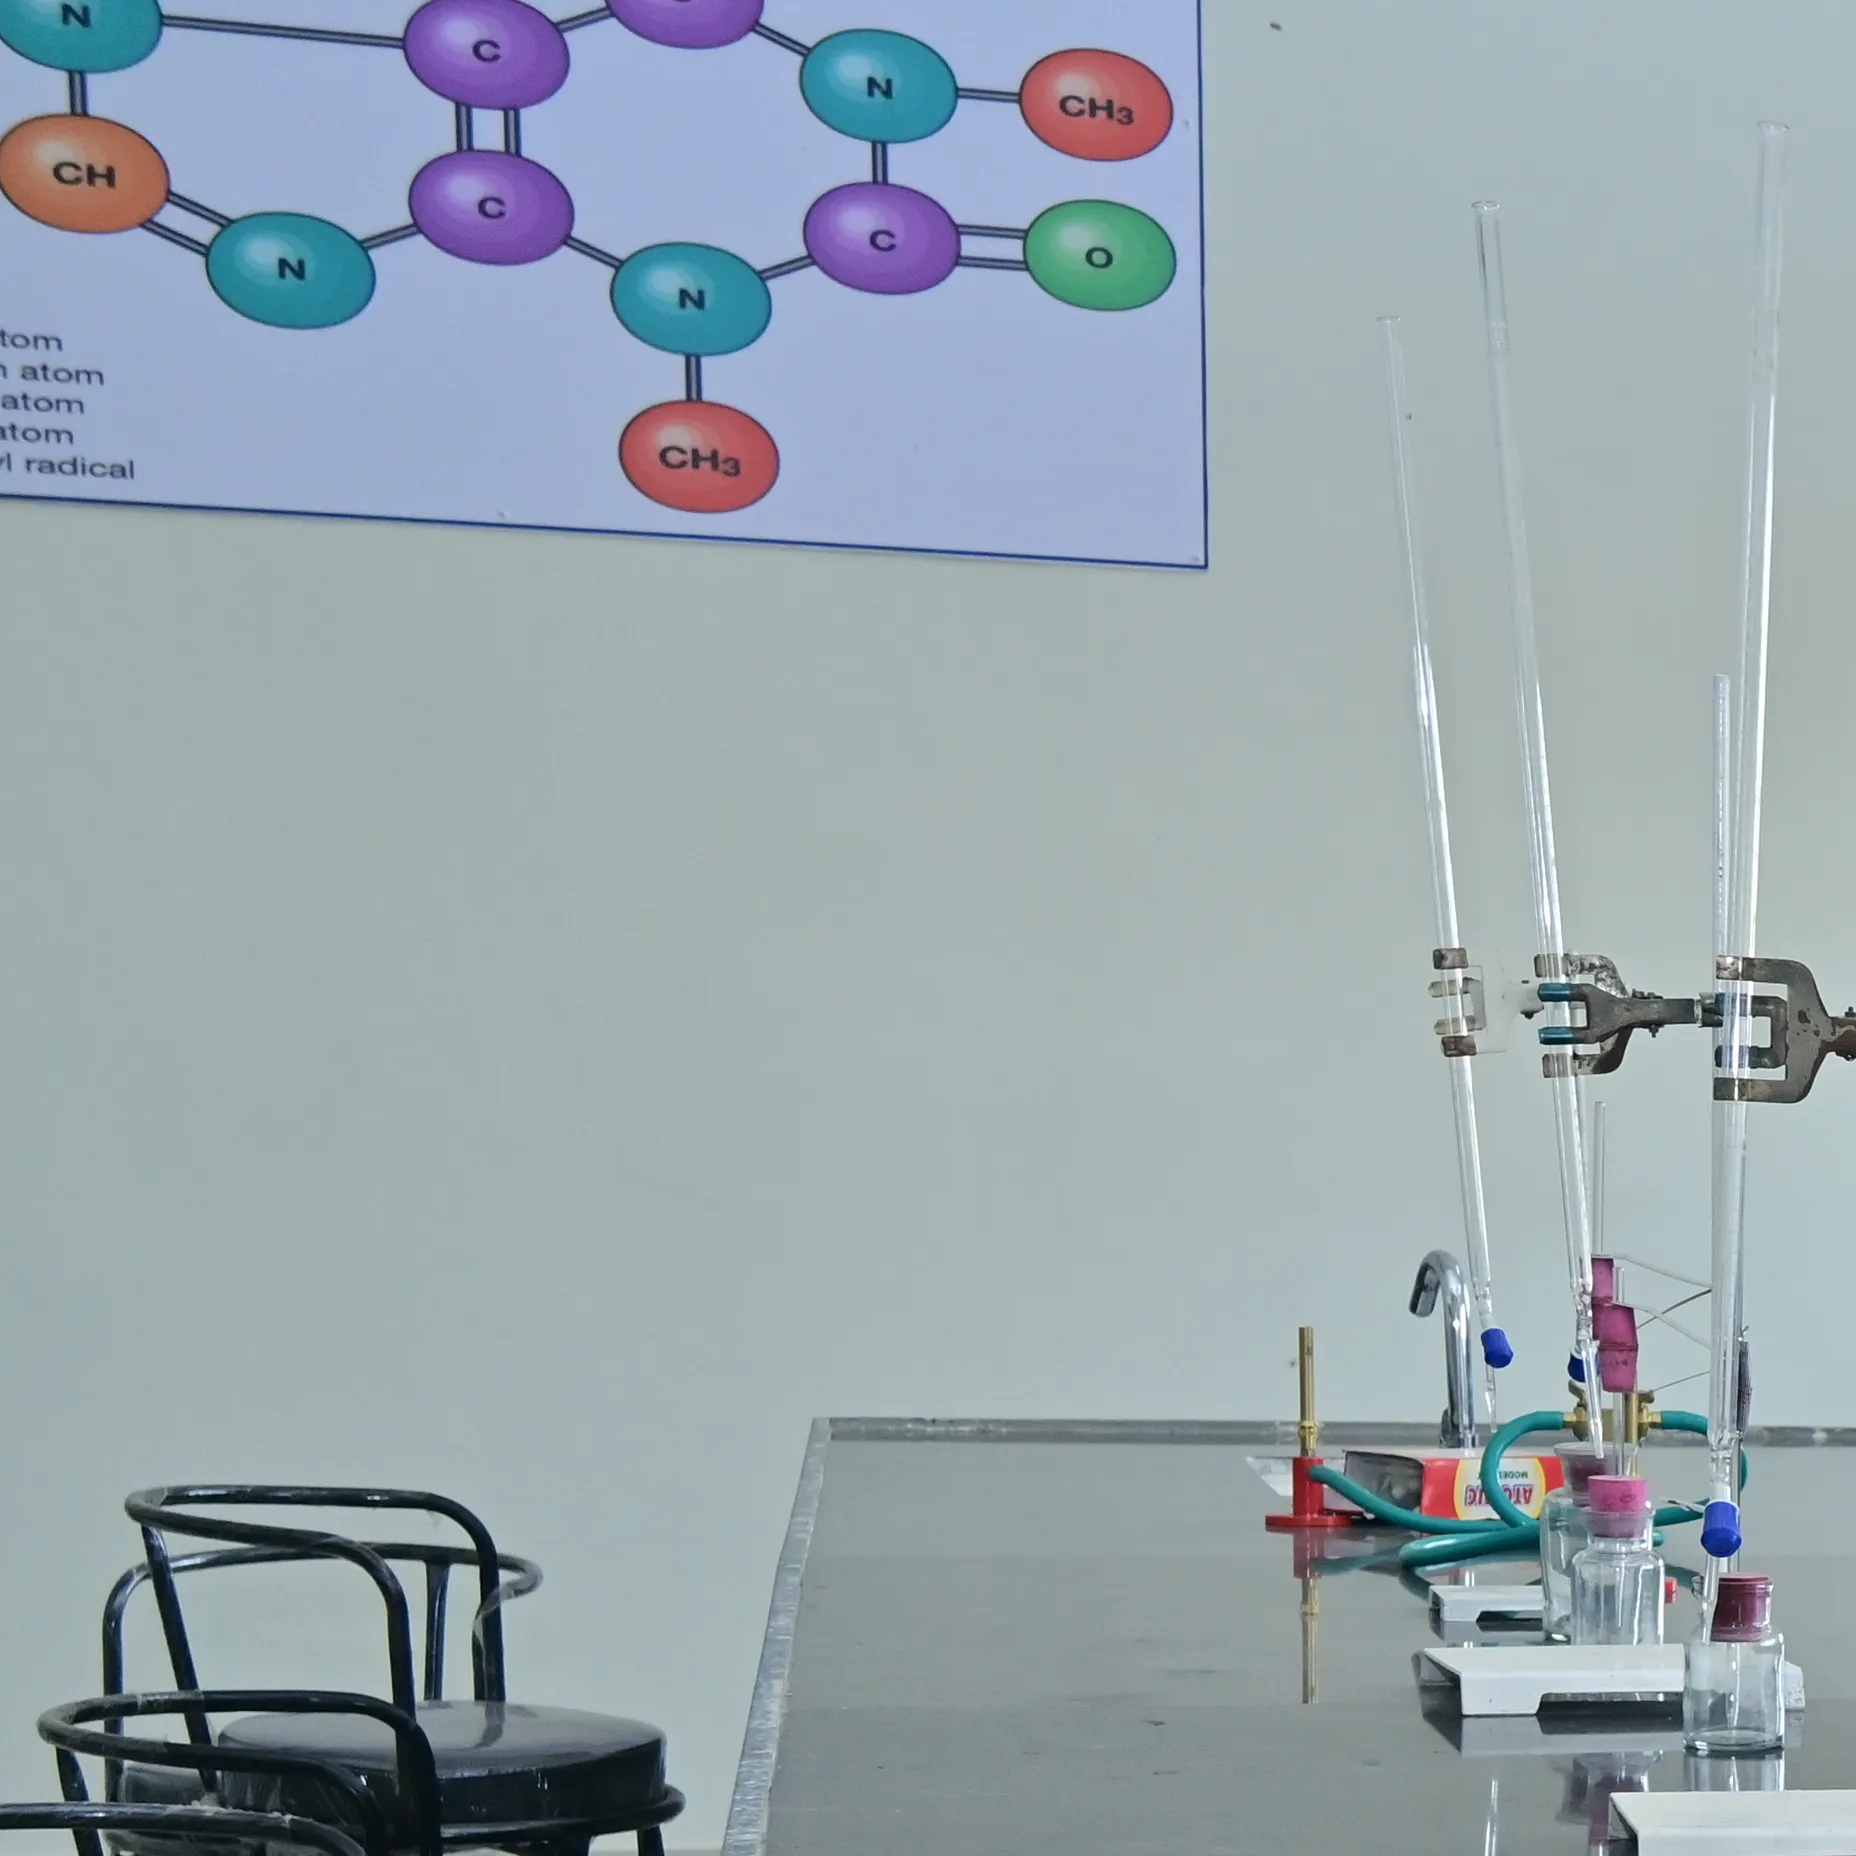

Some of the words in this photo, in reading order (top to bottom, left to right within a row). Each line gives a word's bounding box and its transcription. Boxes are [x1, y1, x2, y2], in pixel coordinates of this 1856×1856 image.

[61, 3, 91, 29] N
[472, 39, 501, 64] C
[867, 76, 895, 101] N
[52, 161, 117, 190] CH
[477, 196, 508, 220] C
[869, 229, 898, 253] C
[277, 257, 307, 282] N
[1085, 246, 1115, 269] O
[678, 288, 706, 312] N
[21, 364, 105, 386] atom
[1, 393, 85, 415] atom
[25, 456, 135, 480] radical
